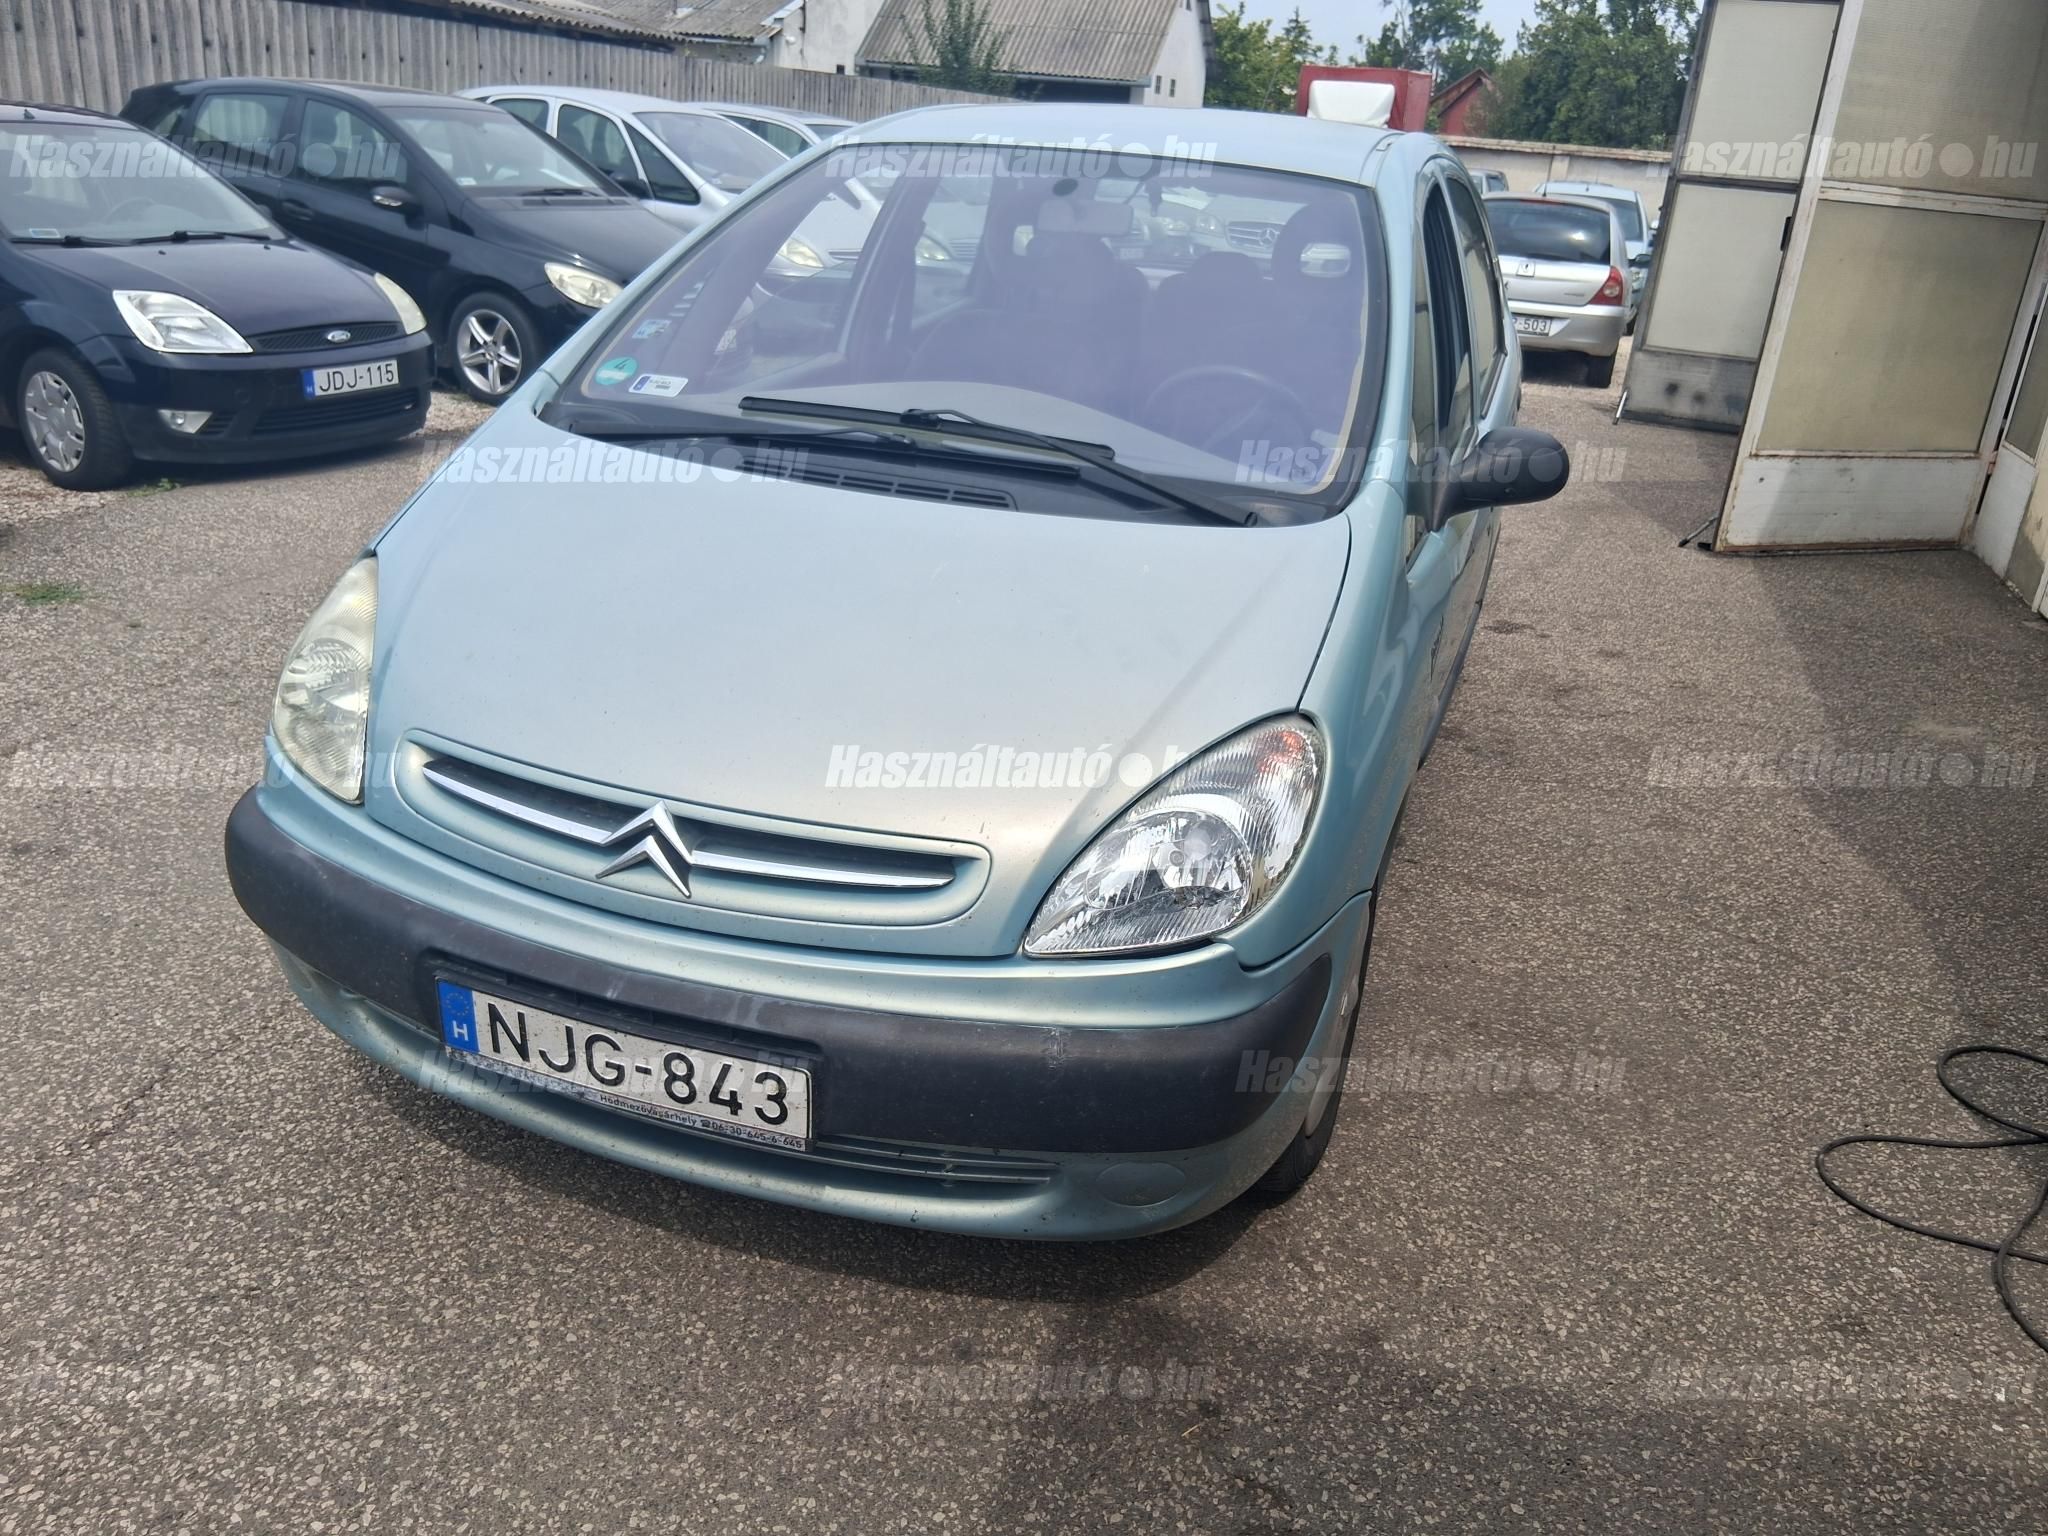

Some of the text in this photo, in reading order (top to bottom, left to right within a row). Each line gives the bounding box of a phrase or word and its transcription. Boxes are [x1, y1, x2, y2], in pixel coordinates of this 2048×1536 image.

[319, 363, 394, 392] JDJ-115
[454, 1020, 468, 1042] H
[488, 1002, 789, 1126] NJG-843
